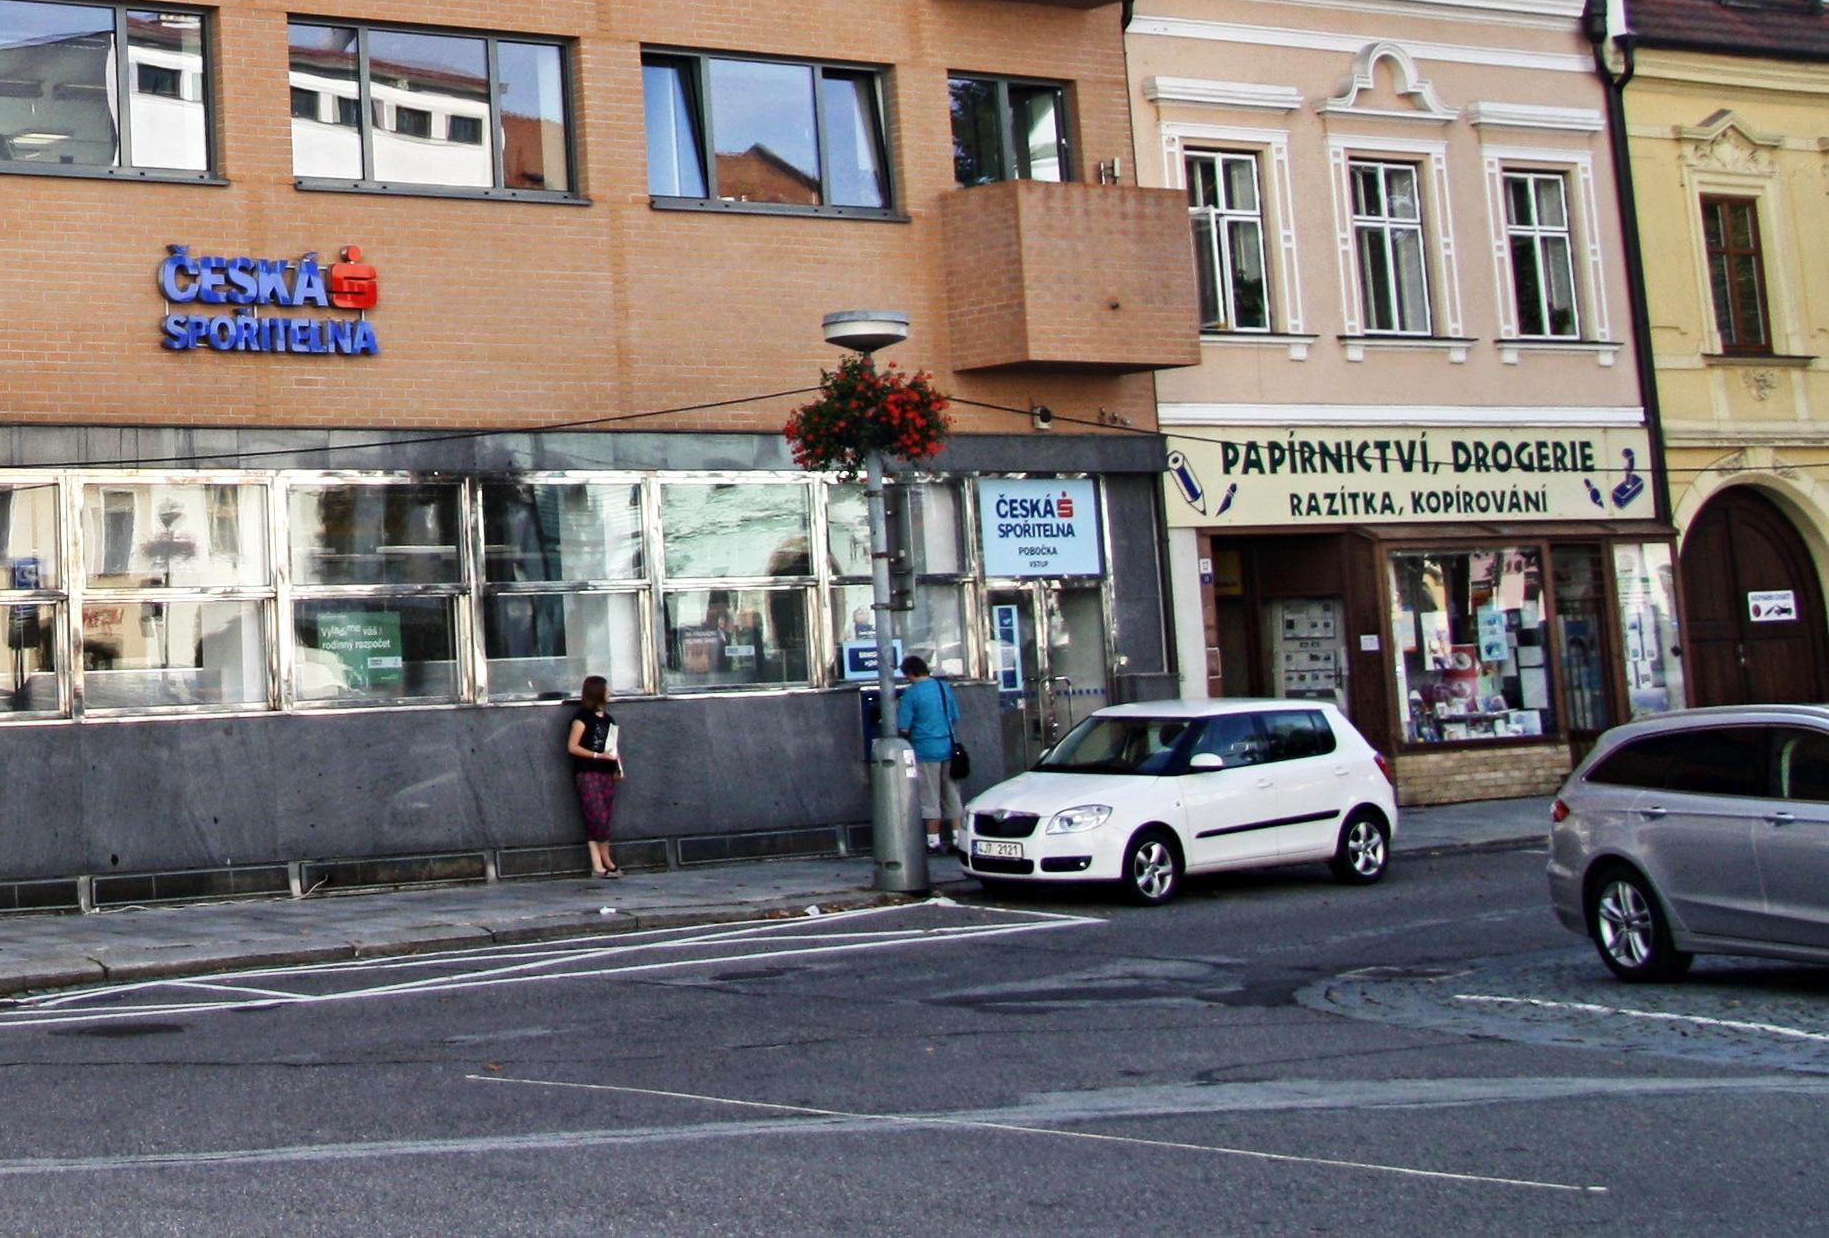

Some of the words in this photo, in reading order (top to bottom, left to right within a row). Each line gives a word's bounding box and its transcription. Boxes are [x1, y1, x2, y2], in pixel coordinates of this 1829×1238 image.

[159, 244, 328, 307] ČESKÁ
[162, 308, 379, 355] SPOŘITELNA
[1221, 431, 1438, 475] PAPÍRNICTVÍ,
[1451, 440, 1595, 473] DROGERIE
[996, 494, 1055, 518] ČESKÁ
[1289, 485, 1403, 517] RAZÍTKA,
[1411, 484, 1548, 514] KOPÍROVÁNÍ
[998, 520, 1075, 538] SPOŘITELNA
[1018, 545, 1058, 555] POBOČKA
